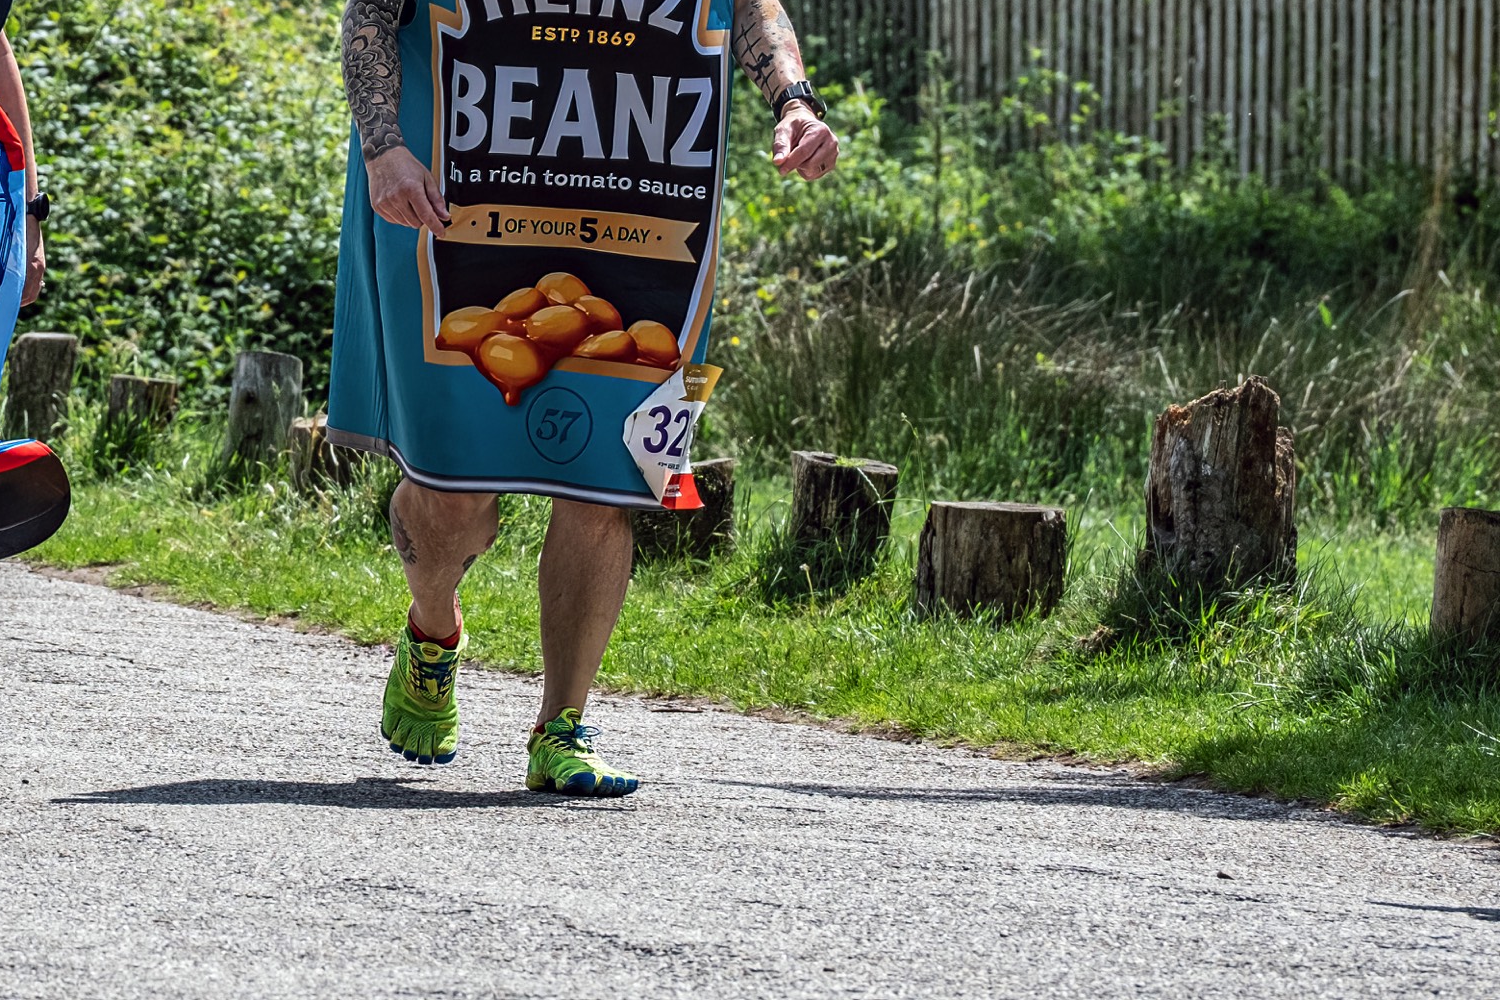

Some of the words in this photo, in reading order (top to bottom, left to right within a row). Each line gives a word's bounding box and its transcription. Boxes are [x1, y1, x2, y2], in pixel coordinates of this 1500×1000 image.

[587, 29, 636, 47] 1869
[448, 58, 713, 168] BEANZ
[469, 168, 482, 183] a
[489, 165, 536, 185] rich
[542, 170, 633, 191] tomato
[638, 178, 707, 200] sauce
[486, 211, 502, 239] 1
[504, 218, 527, 234] OF
[530, 219, 576, 237] YOUR
[579, 217, 598, 244] 5
[601, 228, 614, 241] A
[617, 226, 651, 244] DAY
[536, 408, 583, 444] 57
